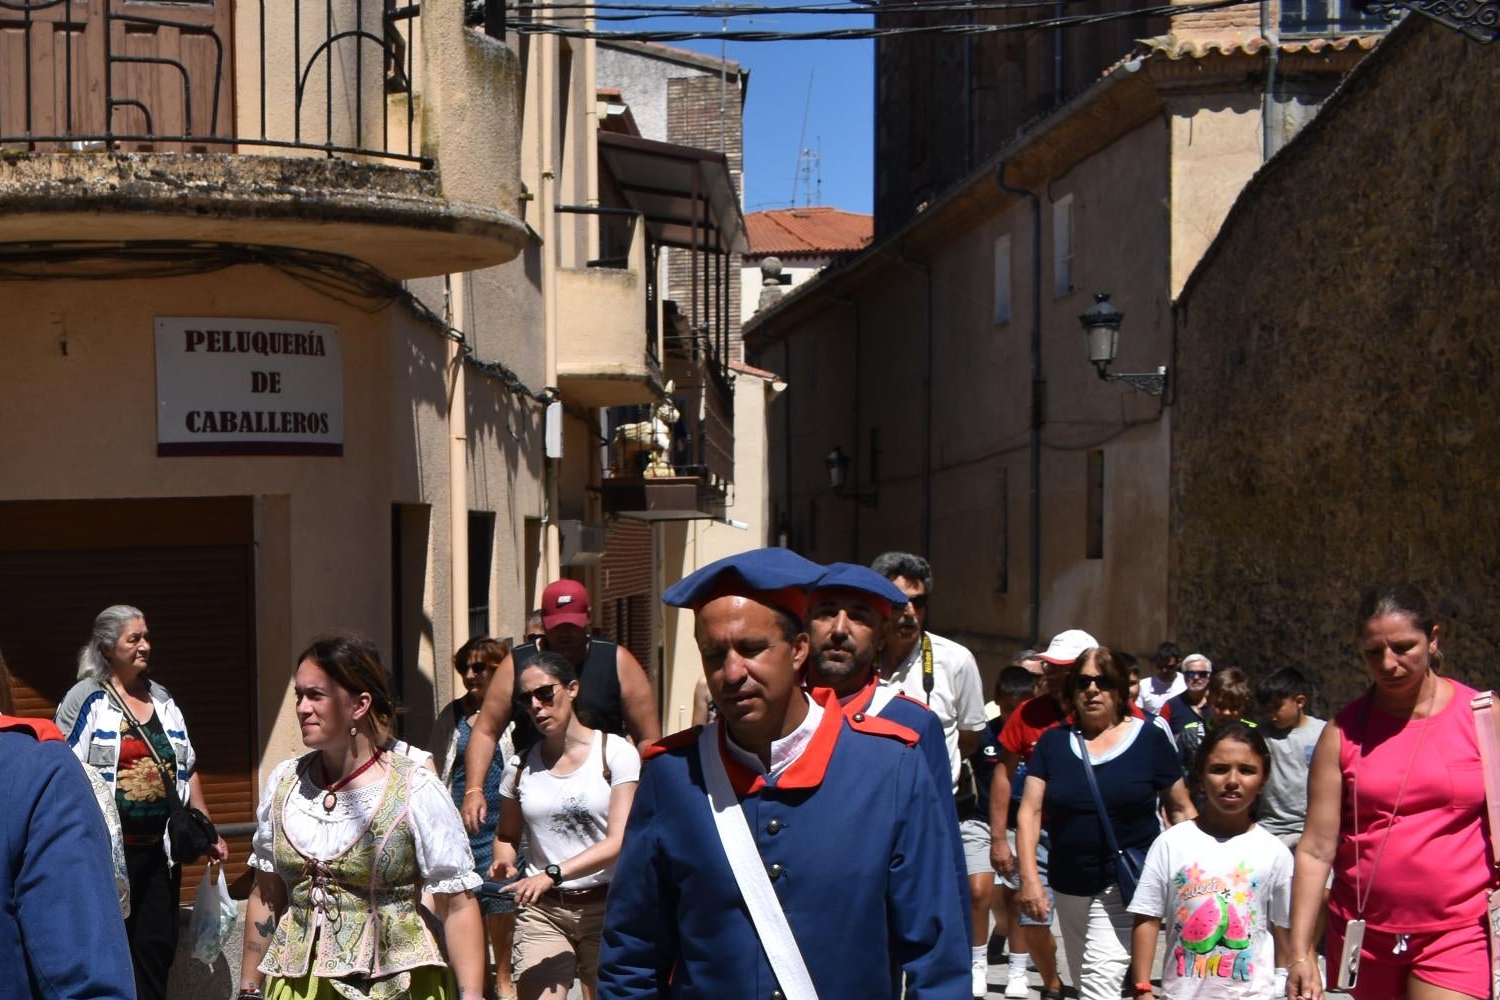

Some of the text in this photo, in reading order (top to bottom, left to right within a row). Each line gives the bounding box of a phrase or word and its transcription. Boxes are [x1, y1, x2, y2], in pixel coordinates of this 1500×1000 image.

[184, 330, 326, 357] PELUQUERÍA
[250, 371, 281, 394] DE
[185, 410, 329, 434] CABALLEROS
[924, 651, 933, 673] Nikon
